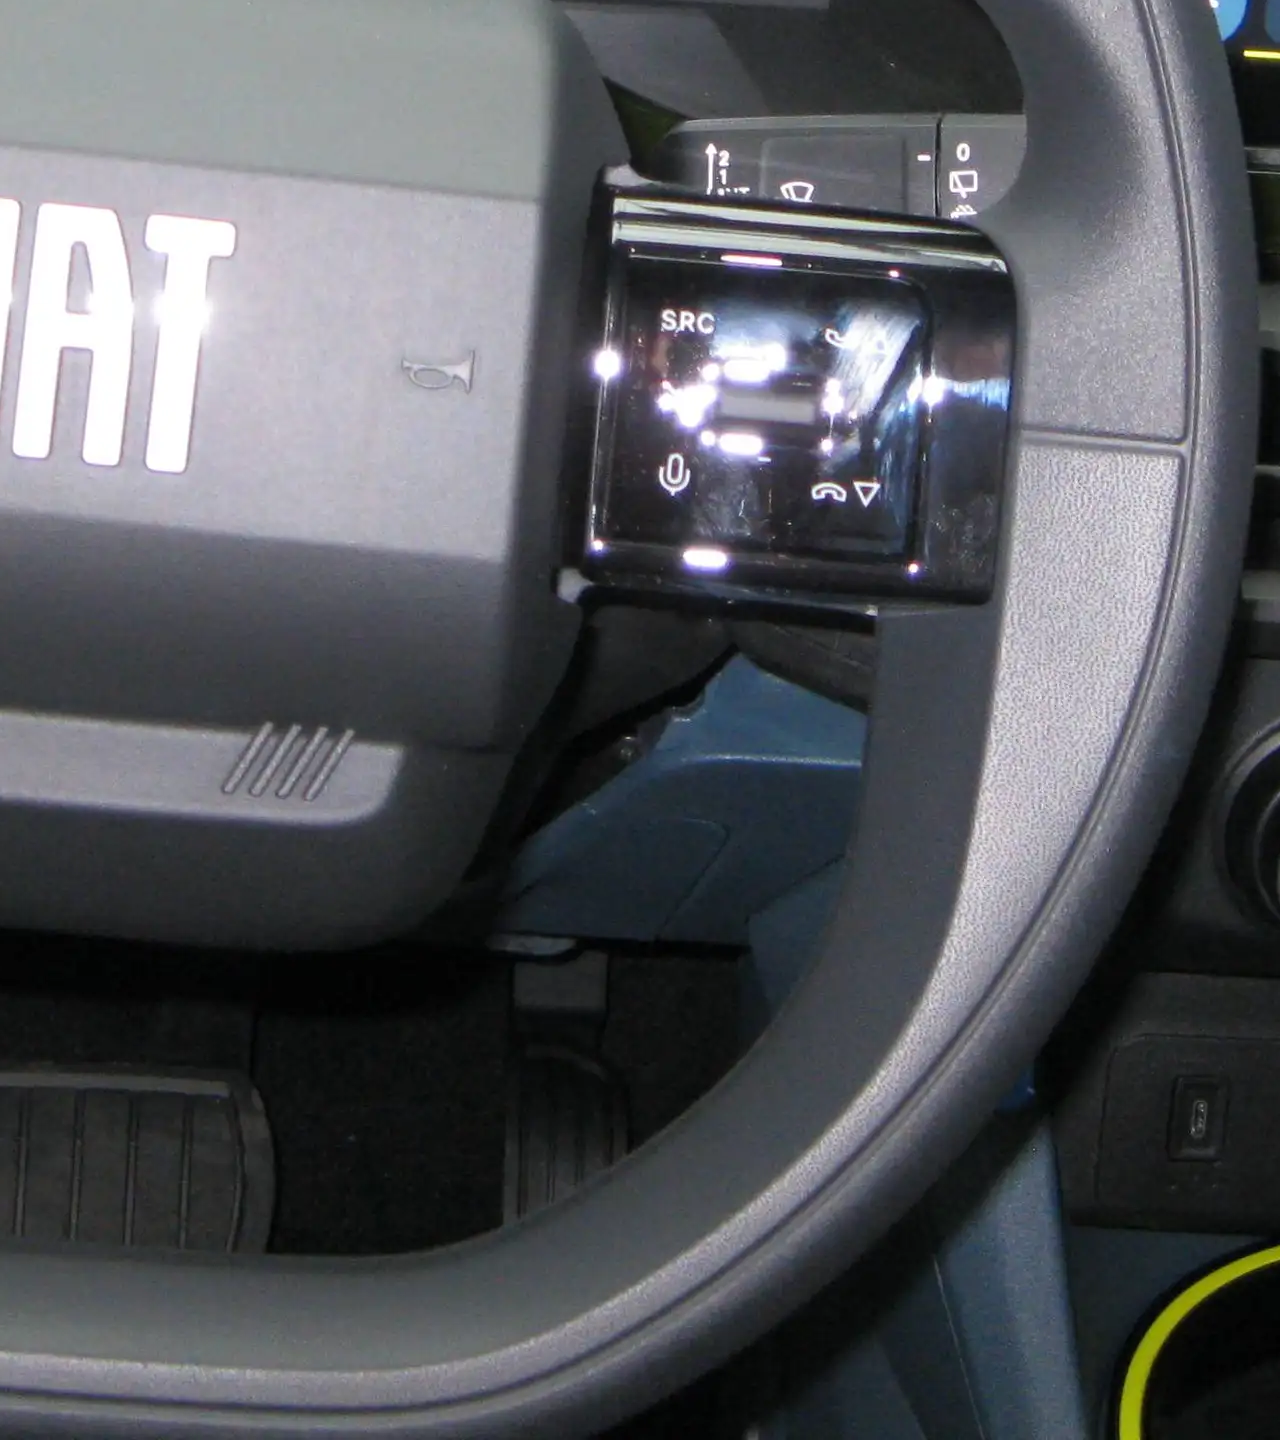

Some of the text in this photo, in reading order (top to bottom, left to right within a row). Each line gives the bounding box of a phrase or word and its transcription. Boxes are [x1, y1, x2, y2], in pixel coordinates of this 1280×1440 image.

[718, 150, 730, 167] 2
[956, 143, 970, 162] 0
[661, 310, 715, 335] SRC
